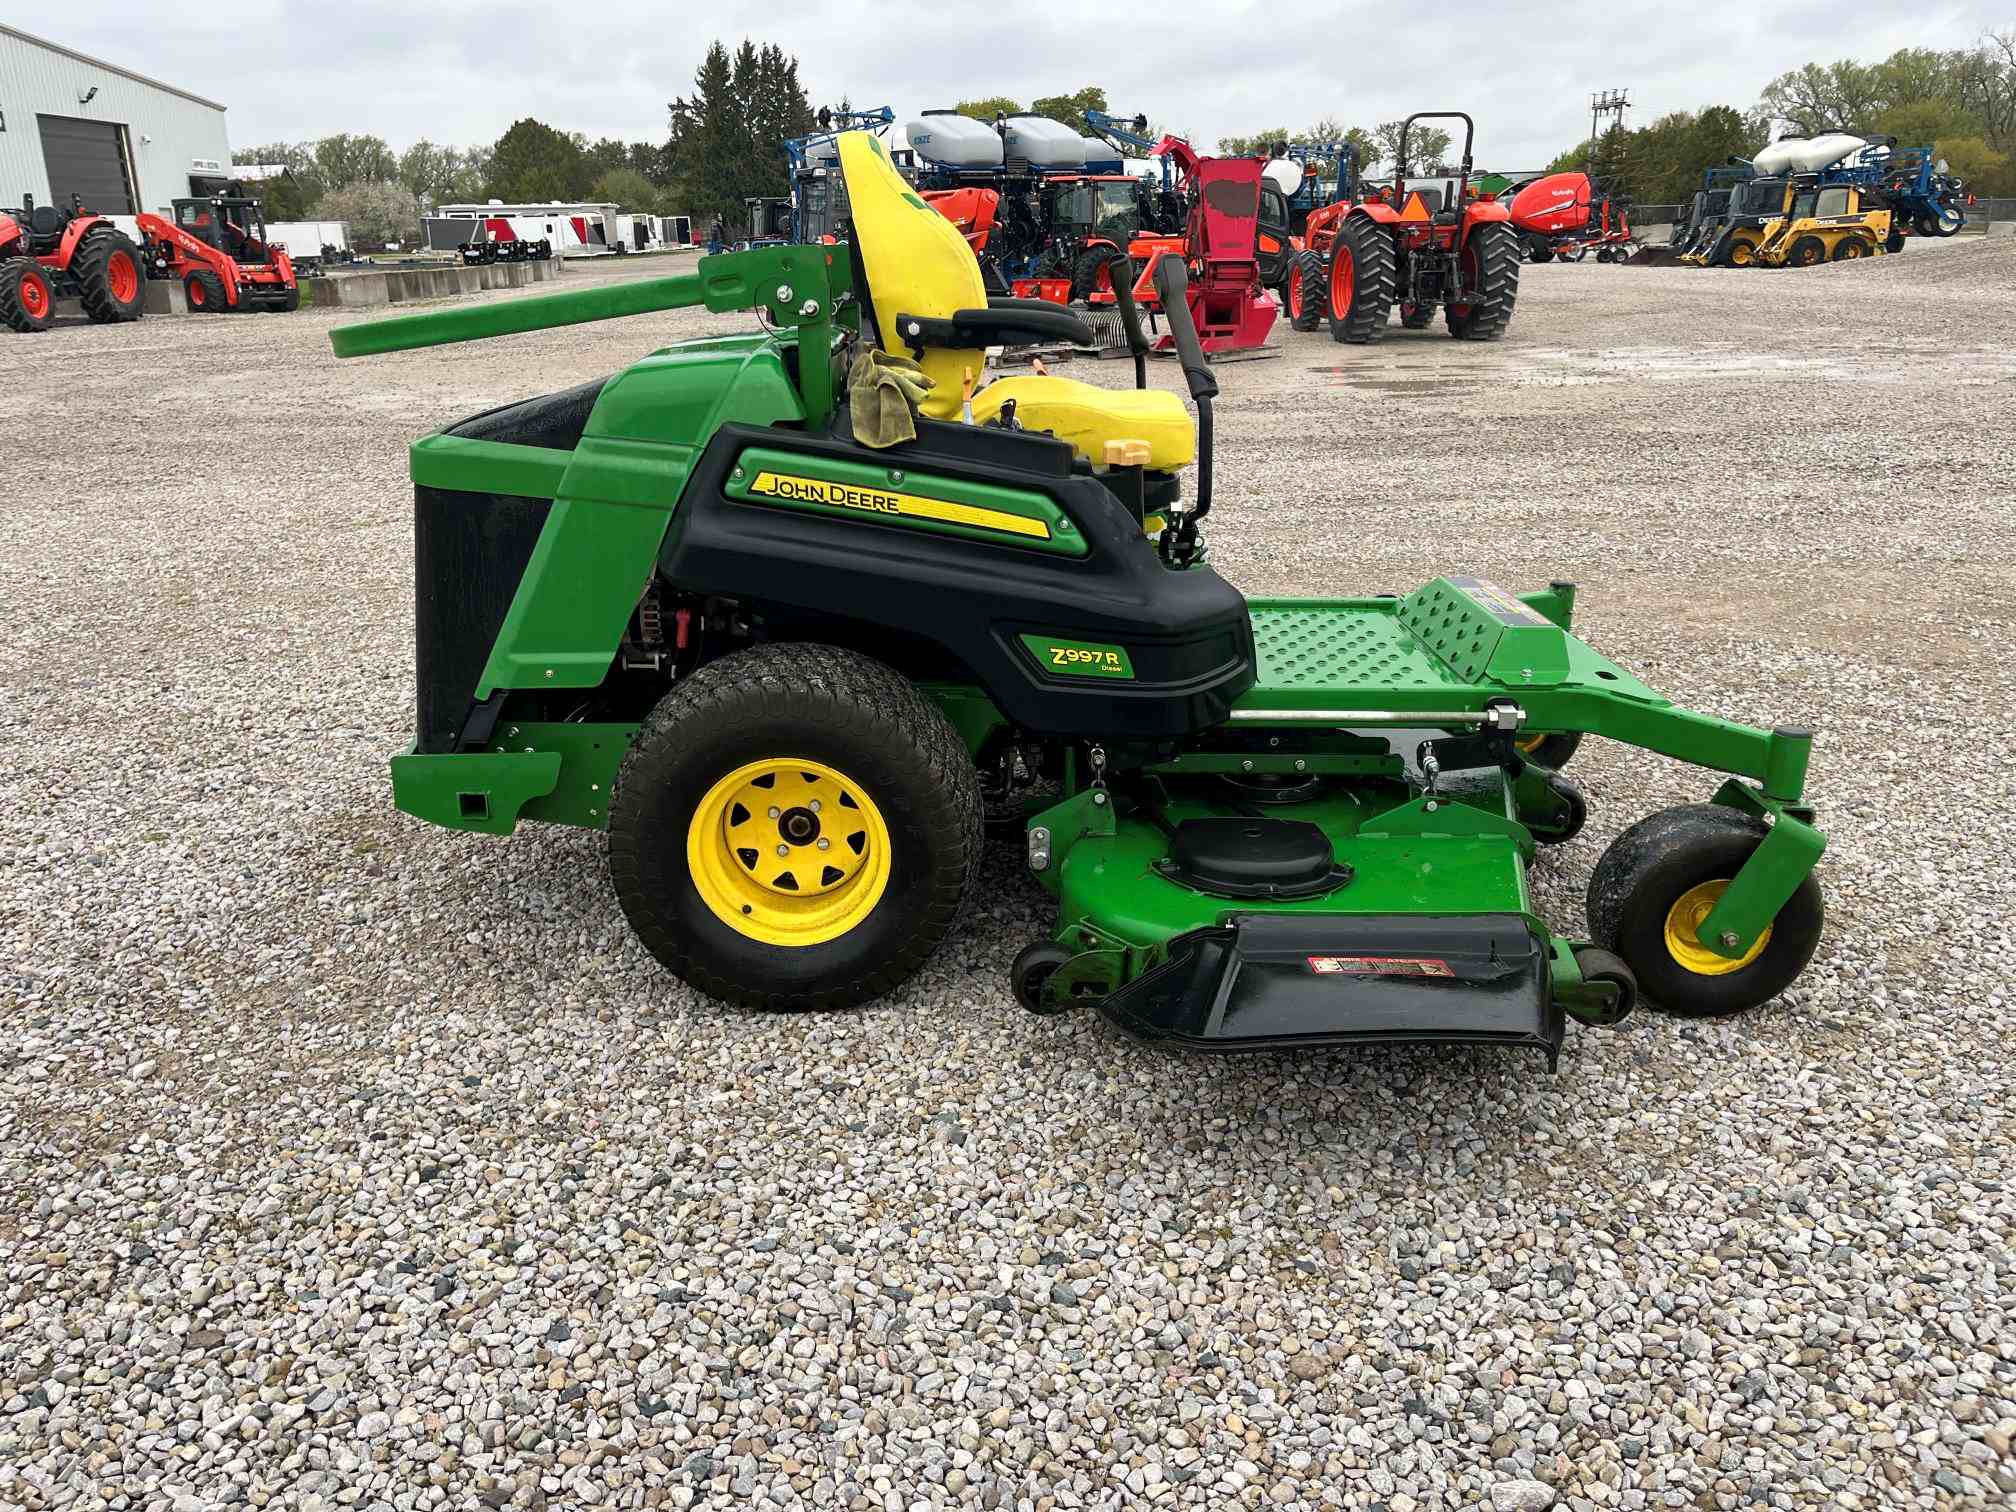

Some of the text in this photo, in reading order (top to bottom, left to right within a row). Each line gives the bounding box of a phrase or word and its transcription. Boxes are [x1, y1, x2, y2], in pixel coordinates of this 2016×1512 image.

[767, 476, 900, 512] JOHN DEERE
[1050, 647, 1120, 665] Z997 R
